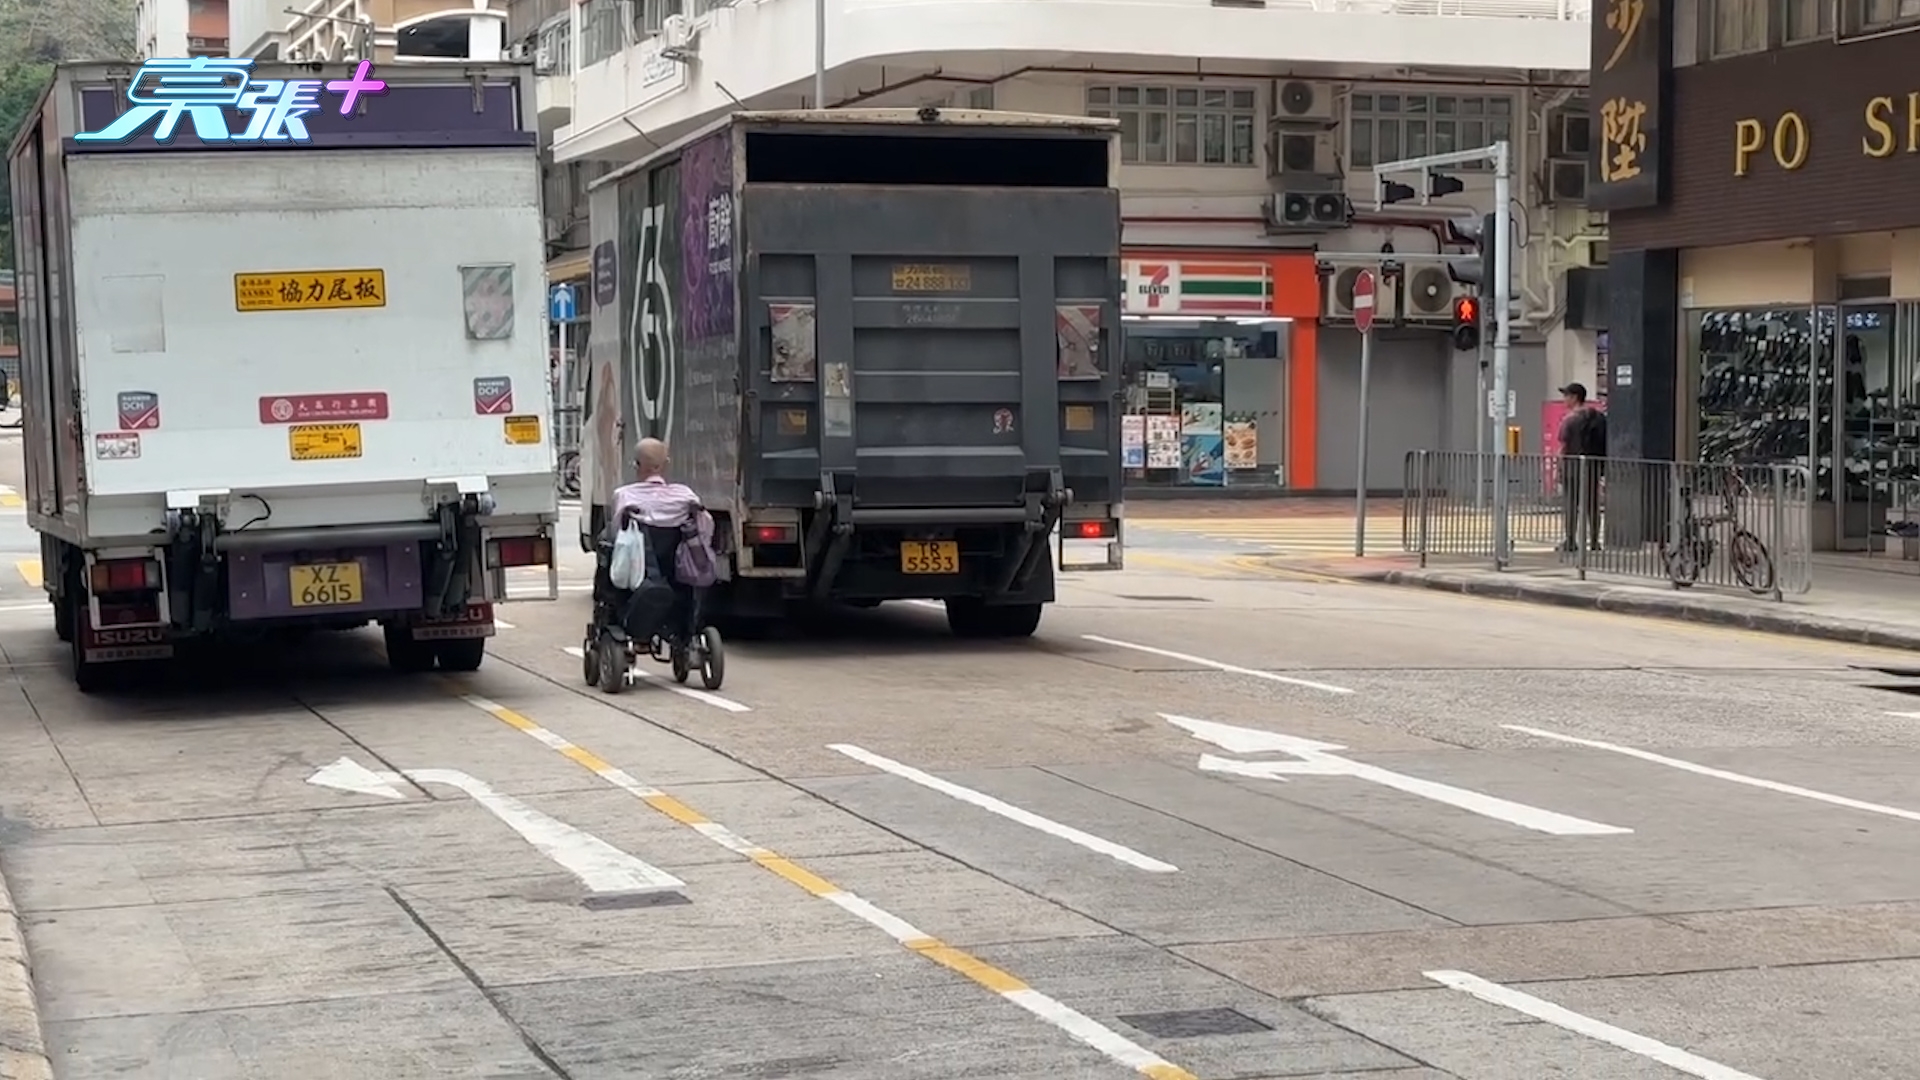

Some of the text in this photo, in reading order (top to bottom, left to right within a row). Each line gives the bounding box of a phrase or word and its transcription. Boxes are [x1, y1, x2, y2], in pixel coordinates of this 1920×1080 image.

[1733, 91, 1920, 177] PO S
[277, 277, 381, 303] 協力尾板
[1139, 265, 1170, 308] 7
[477, 386, 499, 396] DCH
[122, 401, 144, 411] DCH
[918, 542, 941, 558] TR
[907, 556, 954, 571] 5553
[311, 565, 340, 584] XZ
[302, 584, 352, 604] 6615
[93, 628, 163, 645] ISUZU
